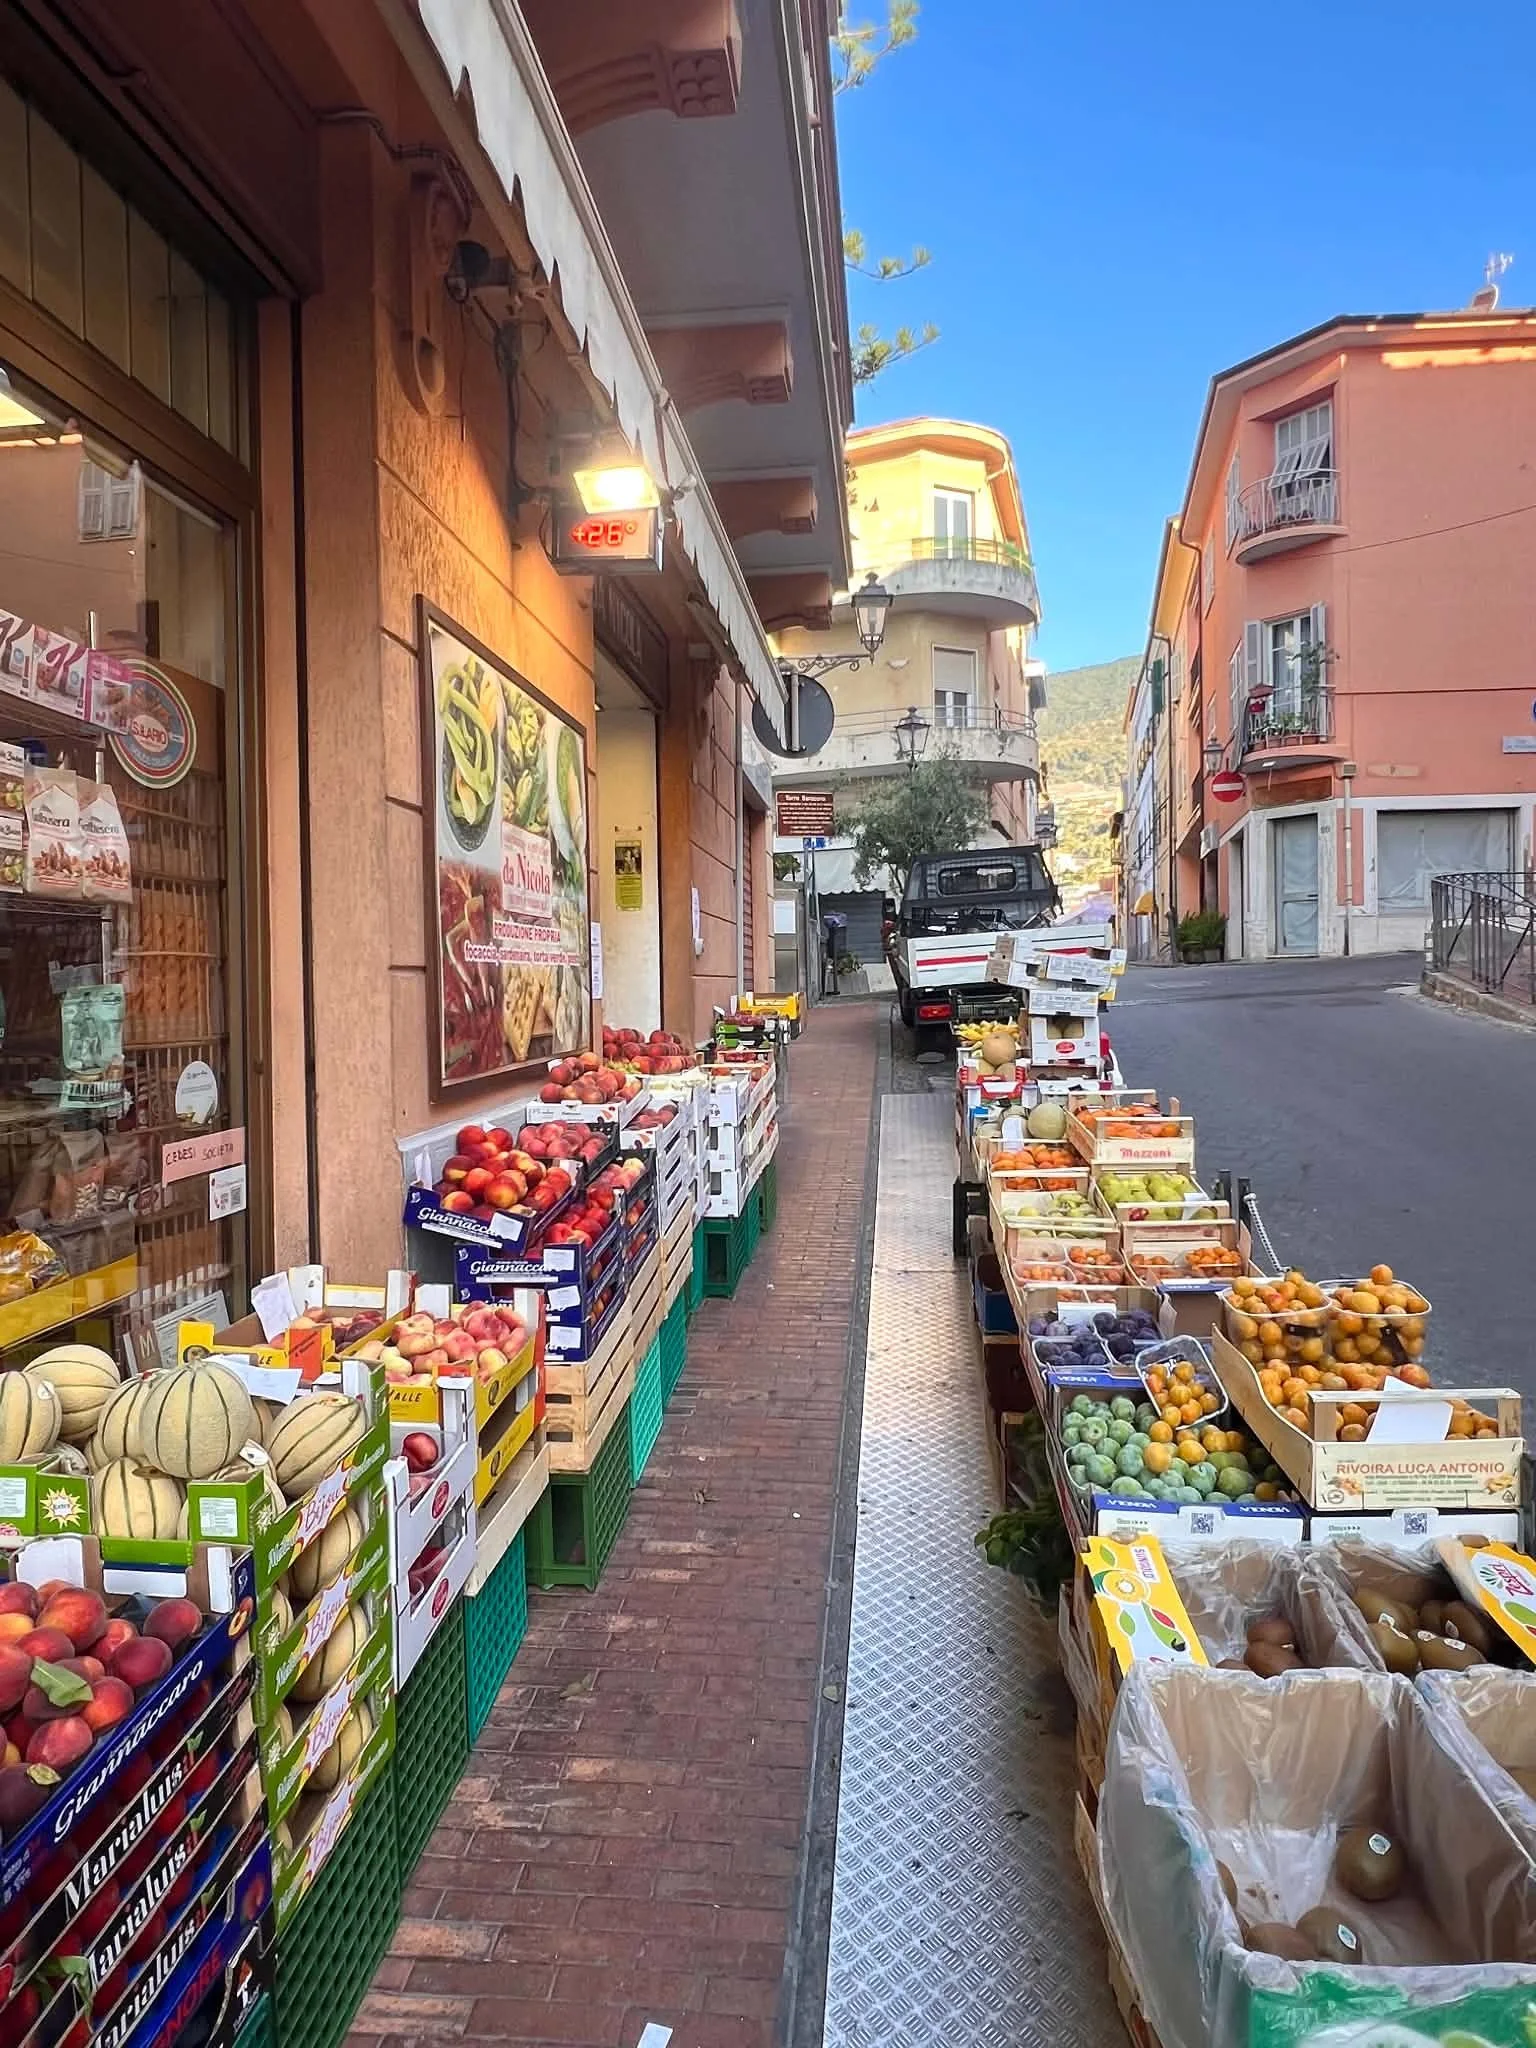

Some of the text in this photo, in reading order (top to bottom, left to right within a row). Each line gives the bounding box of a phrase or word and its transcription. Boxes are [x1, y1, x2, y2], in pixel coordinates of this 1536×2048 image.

[503, 853, 551, 895] da Nicola
[494, 922, 561, 943] PRODUZIONE PROPRIA
[1119, 1147, 1172, 1159] Mazzoni
[1336, 1462, 1505, 1475] RIVOIRA LUCA ANTONIO
[53, 1659, 203, 1844] Giannaccaro
